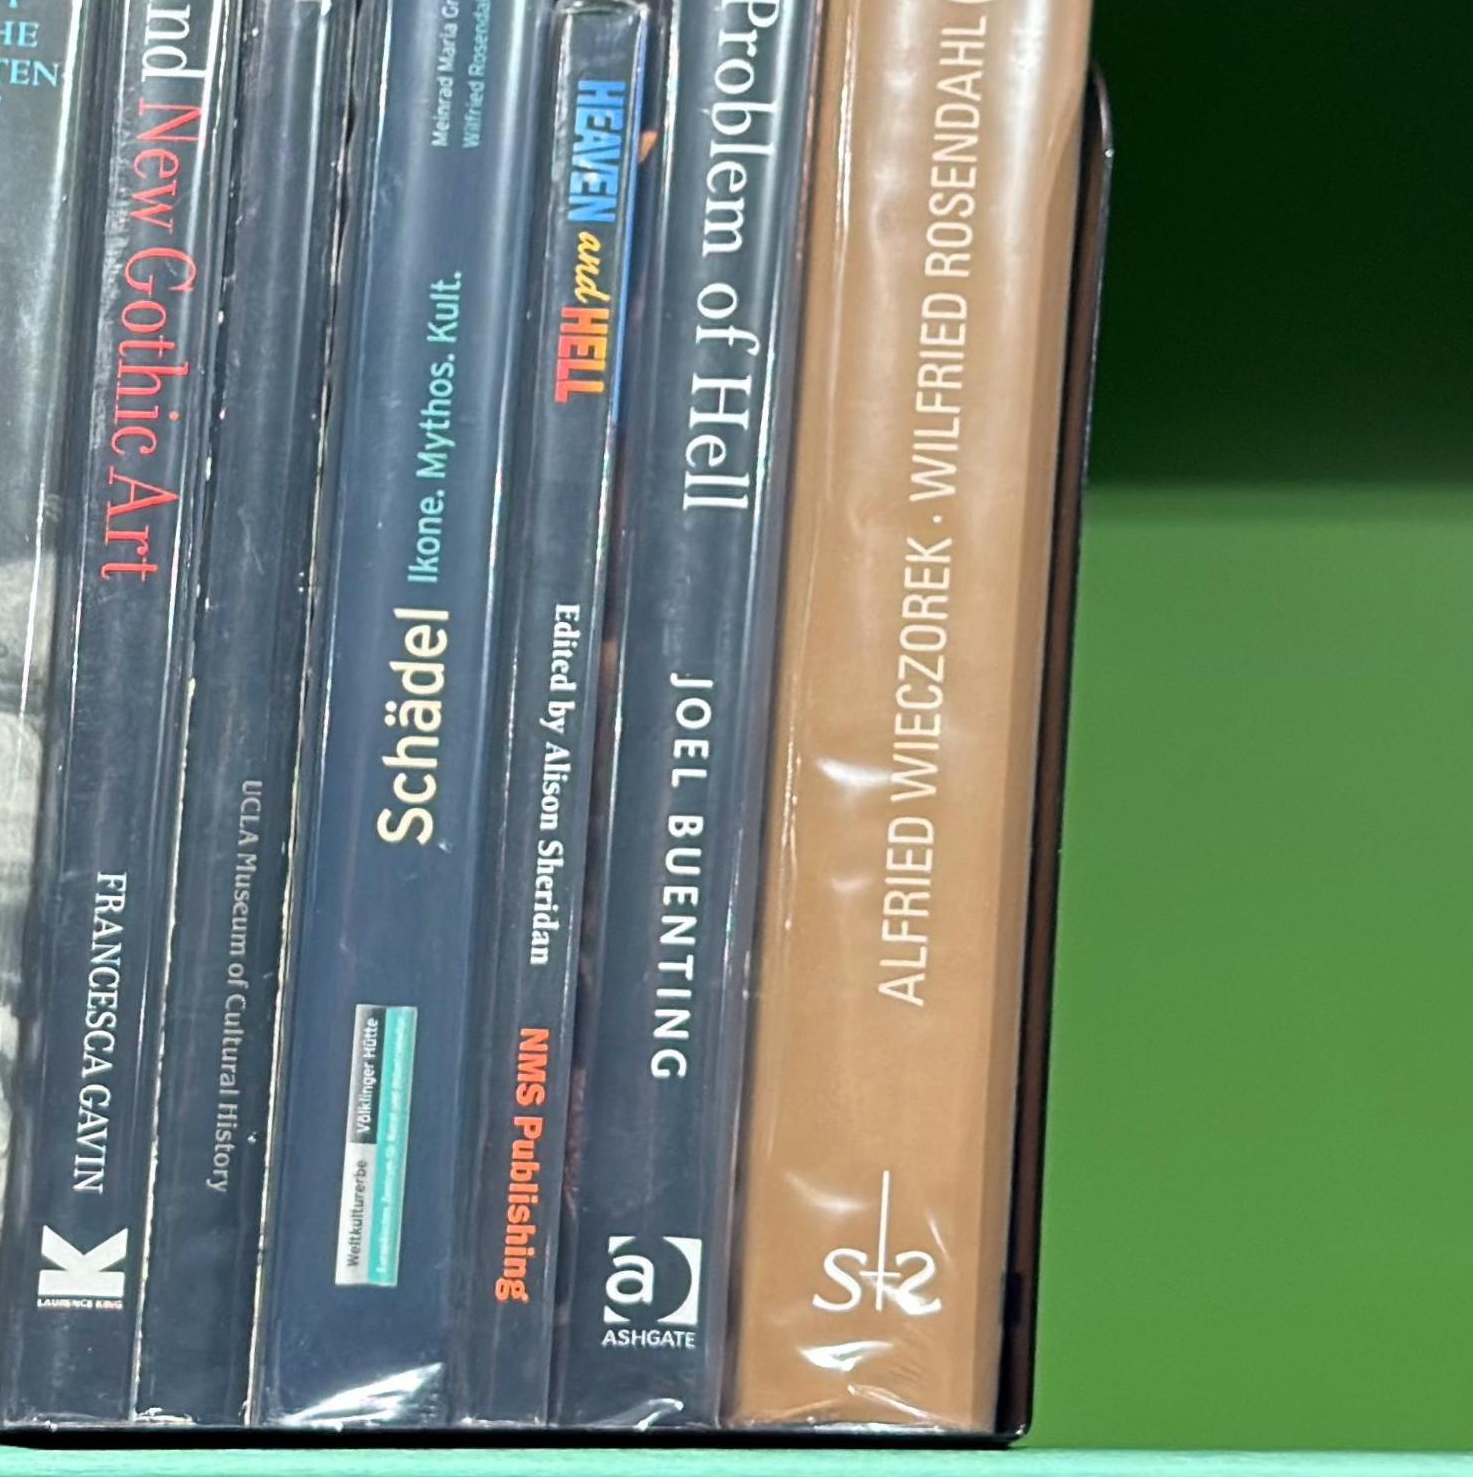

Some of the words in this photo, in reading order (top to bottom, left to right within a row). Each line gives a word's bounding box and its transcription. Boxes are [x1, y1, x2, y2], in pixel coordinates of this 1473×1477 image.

[437, 22, 458, 72] Maria
[431, 76, 454, 147] Meinrad
[567, 79, 627, 223] HEAVEN
[925, 15, 988, 280] ROSENDAHL
[129, 97, 207, 234] New
[425, 270, 462, 345] Kult.
[573, 230, 611, 304] and
[110, 247, 198, 456] Gothic
[555, 306, 610, 404] HELL
[694, 285, 760, 357] of
[415, 352, 454, 481] Mythos.
[681, 366, 753, 513] Hell
[909, 291, 969, 503] WILFRIED
[100, 466, 181, 582] Art
[407, 488, 445, 585] Ikone.
[549, 603, 581, 692] Edited
[890, 536, 953, 803] WIECZOREK
[377, 607, 449, 847] Schädel
[539, 699, 577, 736] by
[670, 672, 714, 789] JOEL
[238, 780, 263, 848] UCLA
[539, 740, 572, 832] Alison
[230, 853, 257, 958] Museum
[529, 839, 565, 966] Sheridan
[650, 814, 705, 1080] BUENTING
[878, 814, 935, 1007] ALFRIED
[80, 871, 128, 1084] FRANCESCA
[227, 961, 250, 994] of
[218, 995, 248, 1099] Cultural
[515, 1027, 550, 1107] NMS
[72, 1087, 111, 1195] GAVIN
[206, 1102, 239, 1194] History
[37, 1224, 129, 1298] K
[494, 1115, 543, 1304] Publishing
[602, 1328, 697, 1349] ASHGATE
